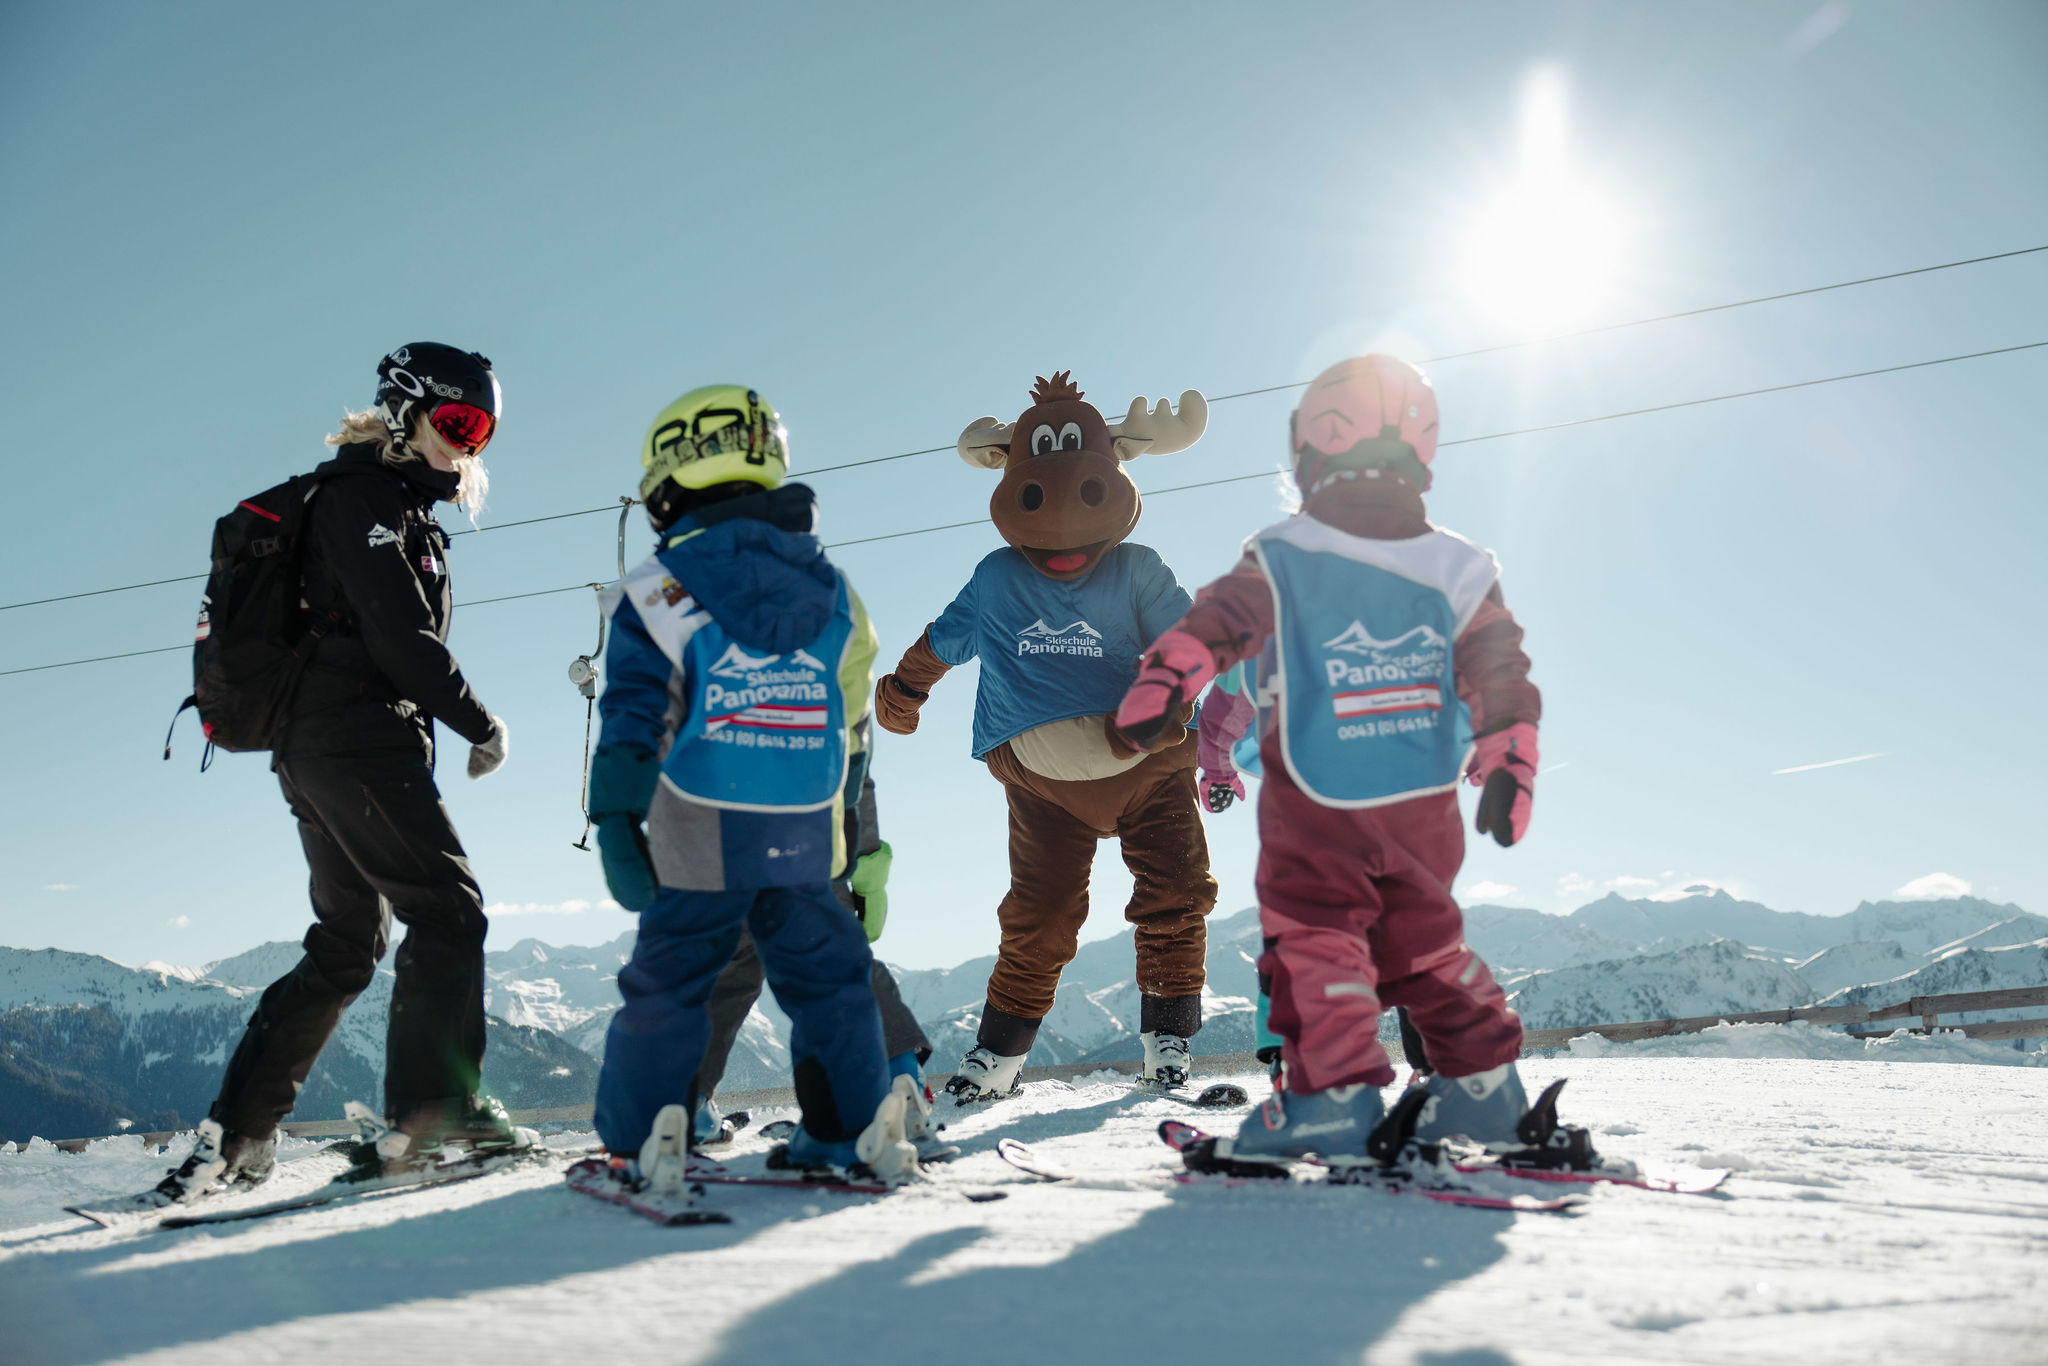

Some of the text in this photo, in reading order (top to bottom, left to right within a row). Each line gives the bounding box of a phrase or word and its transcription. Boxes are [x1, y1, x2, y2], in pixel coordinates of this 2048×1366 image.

[1018, 640, 1103, 657] Panorama
[1045, 636, 1096, 646] Skischule
[746, 667, 817, 687] Skischule
[705, 683, 828, 711] Panorama
[1337, 722, 1376, 740] 0043
